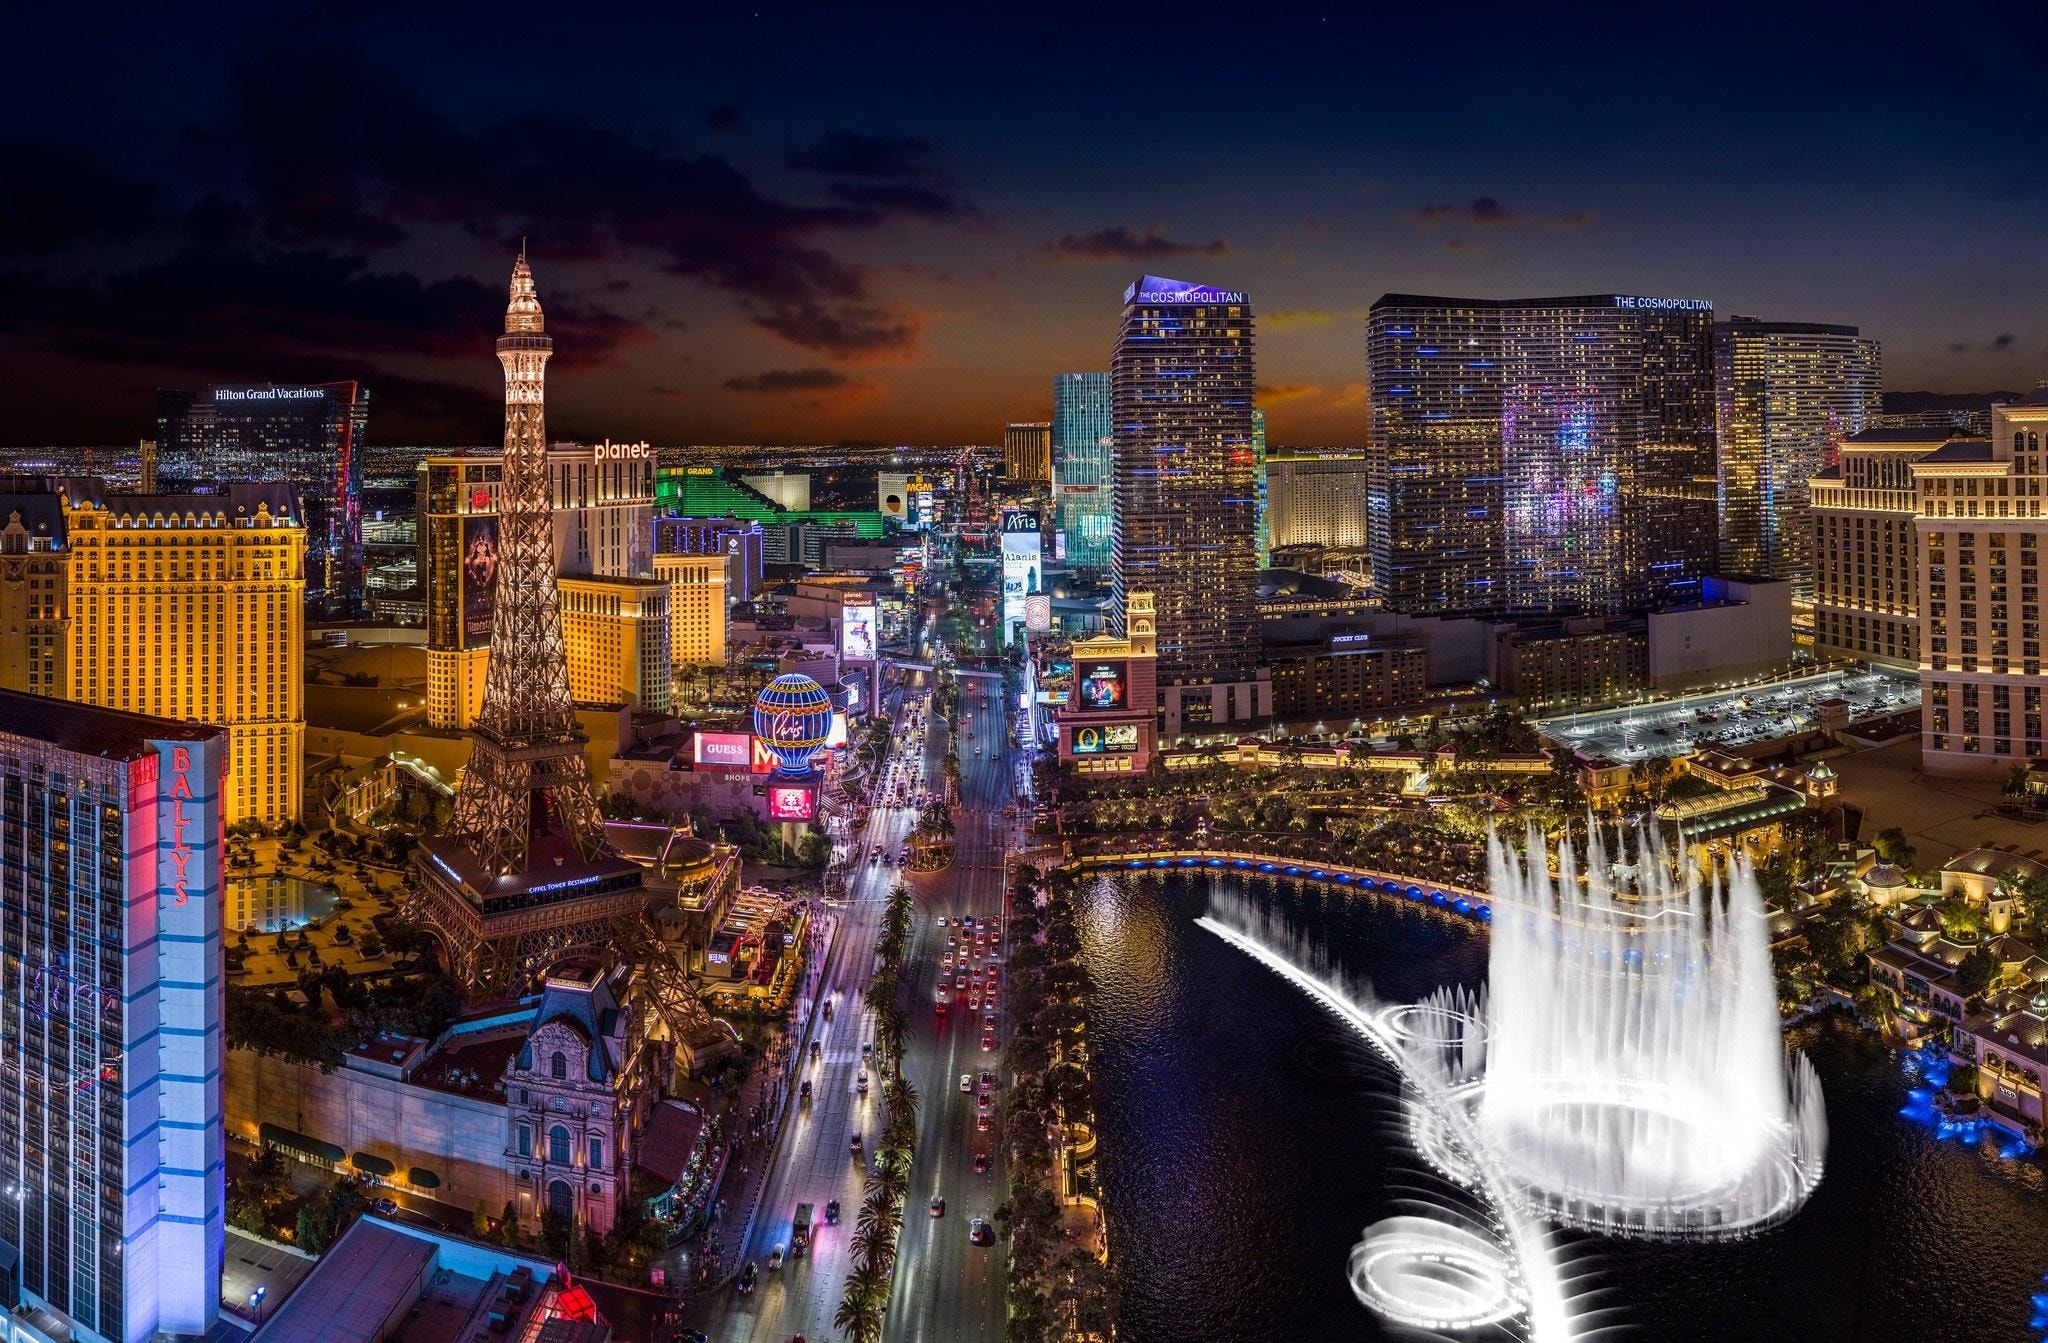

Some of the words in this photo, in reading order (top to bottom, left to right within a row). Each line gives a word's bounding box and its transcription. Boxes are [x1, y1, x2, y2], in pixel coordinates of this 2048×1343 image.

[1151, 291, 1242, 303] COSMOPOLITAN
[1615, 296, 1636, 308] THE
[1638, 297, 1713, 310] COSMOPOLITAN
[215, 389, 245, 400] Hilton
[246, 389, 276, 400] Grand
[276, 387, 324, 399] Vacations
[594, 438, 650, 466] planet
[687, 467, 714, 475] GRAND
[906, 482, 933, 492] MGM
[1007, 514, 1037, 530] Aria
[772, 710, 802, 746] Paris
[707, 744, 743, 754] GUESS
[528, 885, 547, 893] EIFFEL
[547, 881, 566, 890] TOWER
[567, 875, 600, 887] RESTAURANT
